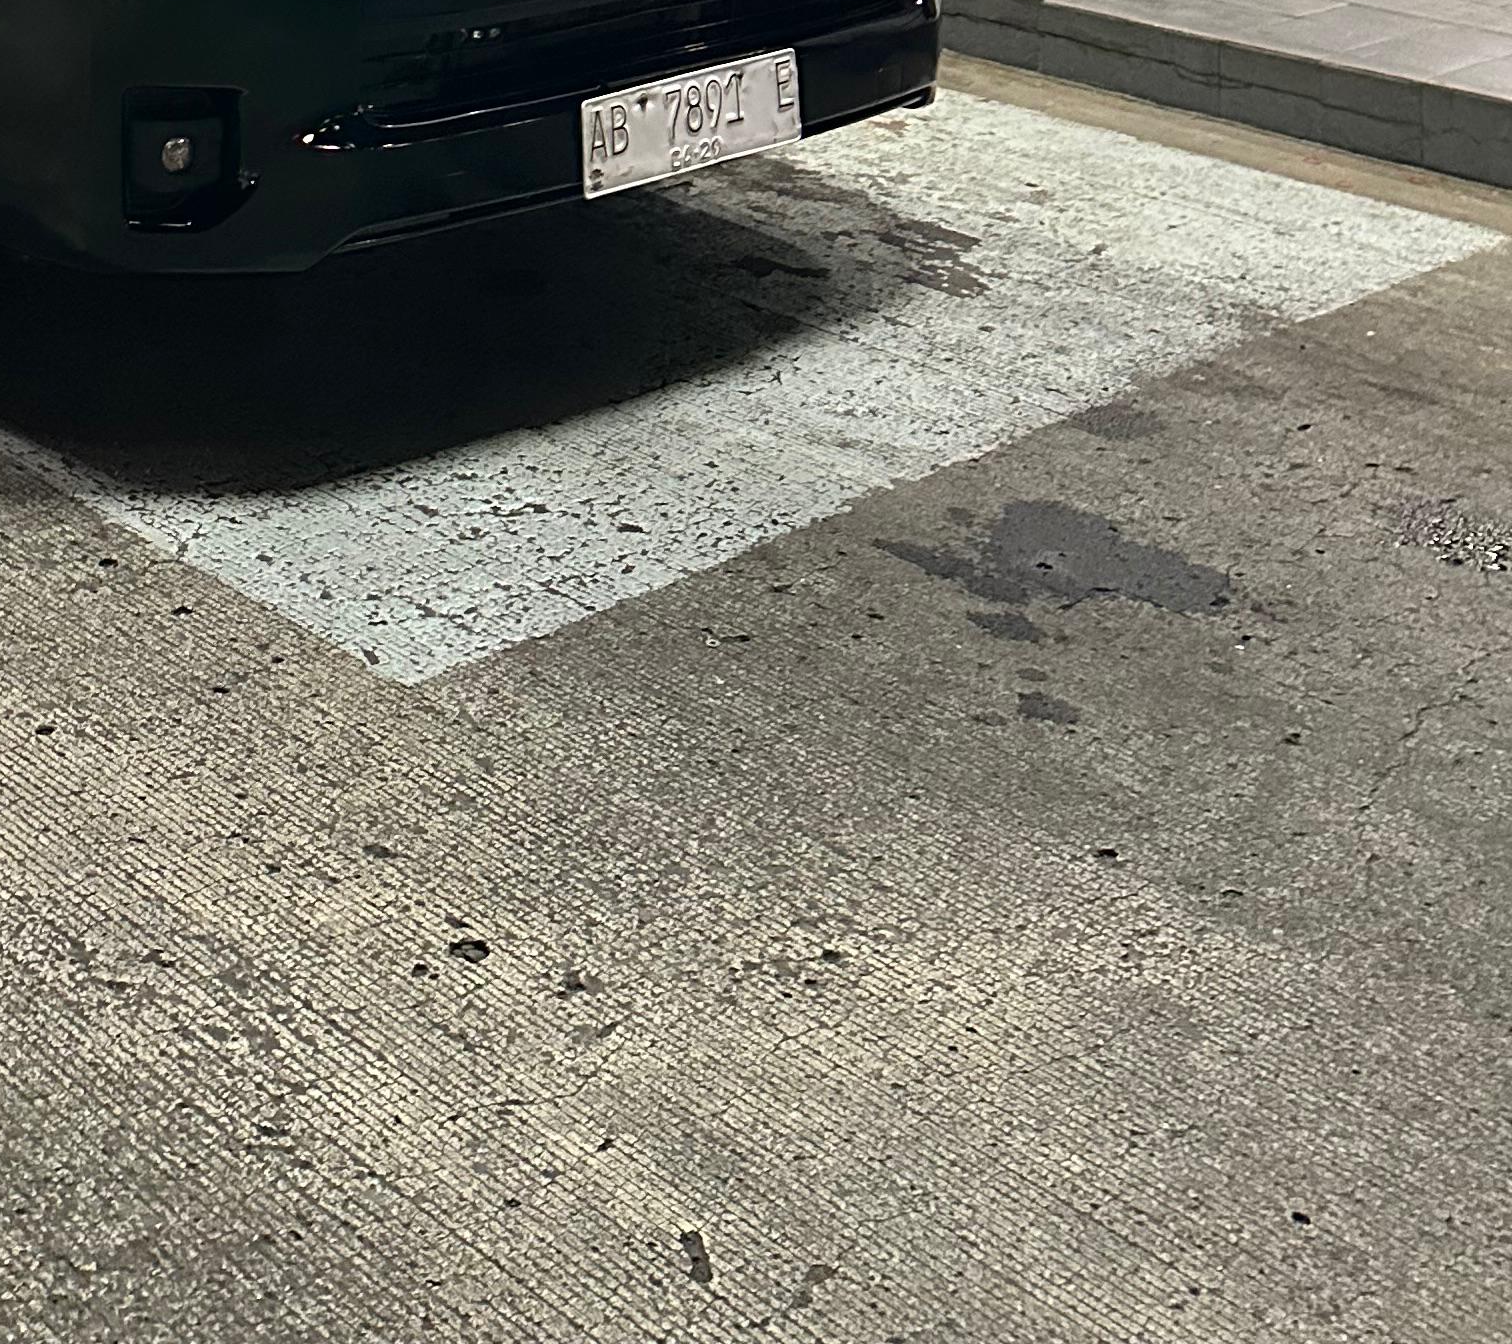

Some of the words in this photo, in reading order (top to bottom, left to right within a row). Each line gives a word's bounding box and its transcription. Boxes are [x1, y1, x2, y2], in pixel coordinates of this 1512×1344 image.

[589, 103, 630, 163] AB
[664, 72, 744, 141] 7891
[774, 58, 795, 112] E
